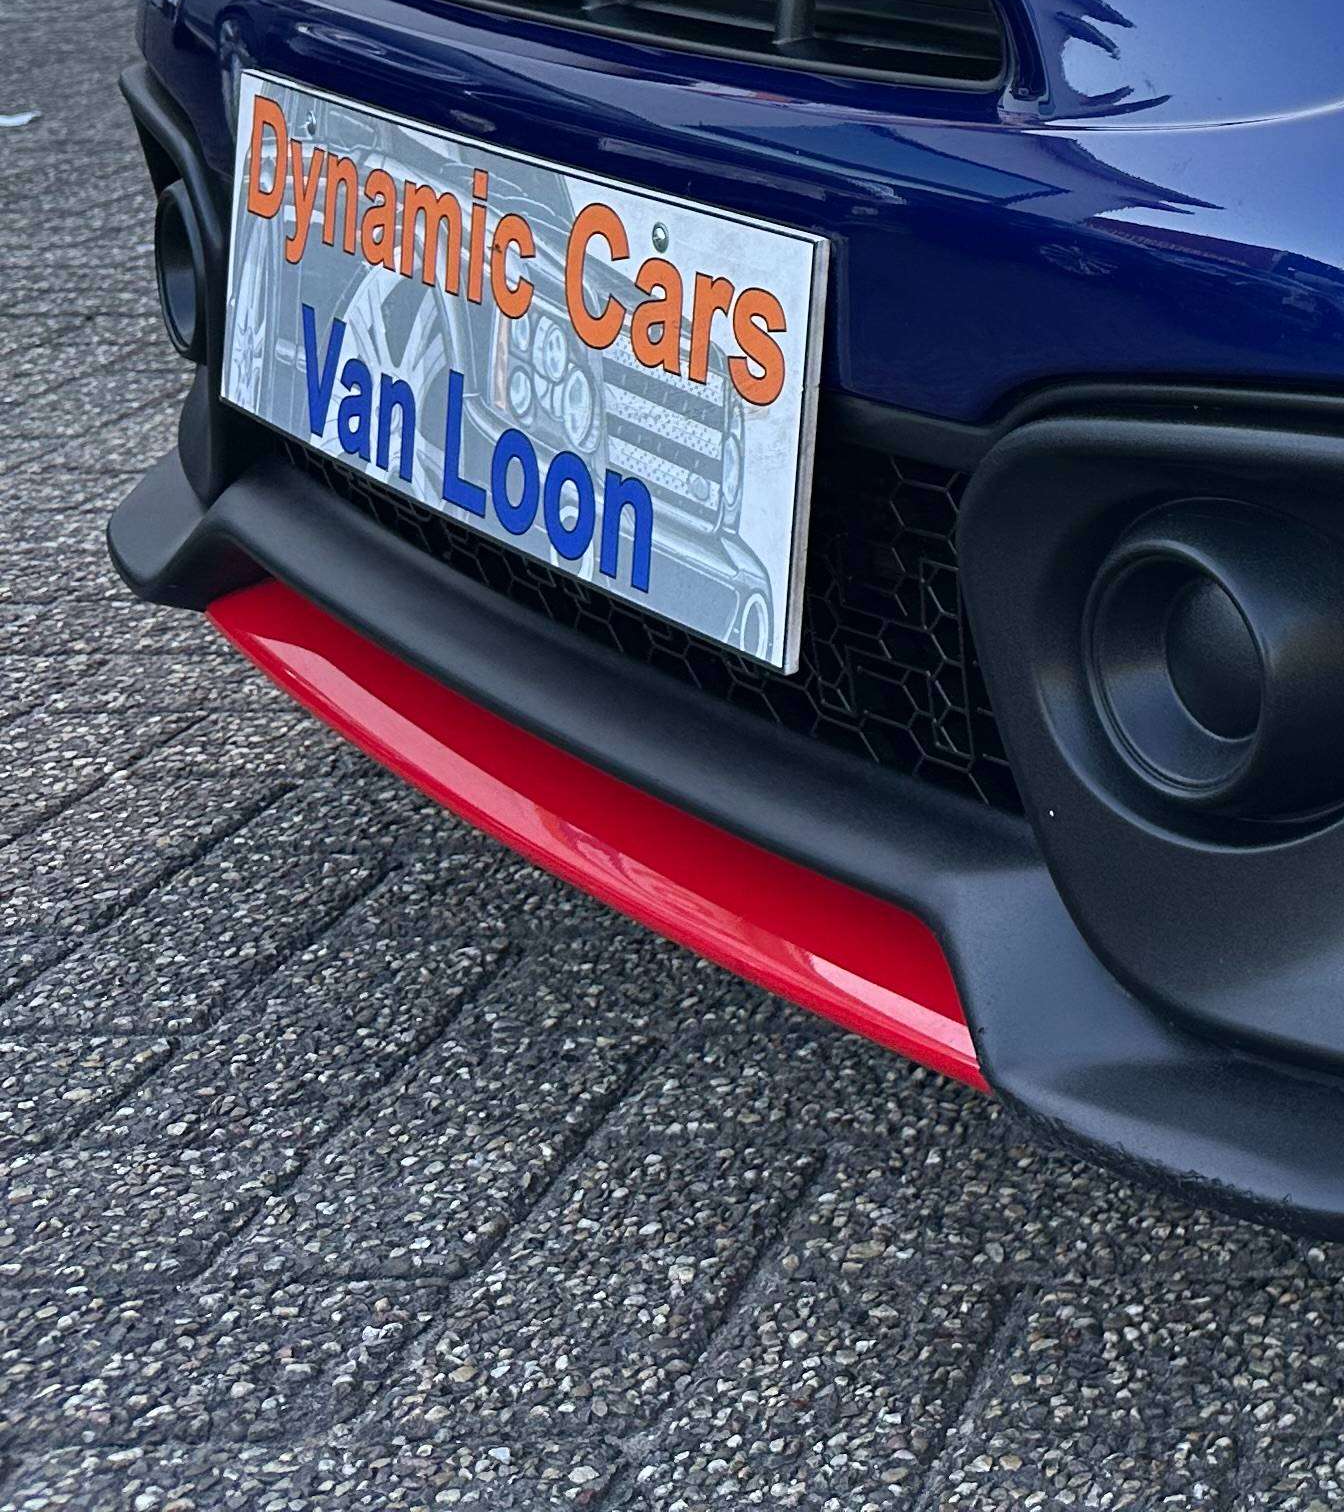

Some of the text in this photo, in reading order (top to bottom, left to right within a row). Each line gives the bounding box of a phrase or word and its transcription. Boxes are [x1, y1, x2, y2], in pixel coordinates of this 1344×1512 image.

[246, 93, 788, 407] Dynamic Cars
[301, 303, 656, 594] Van Loon
